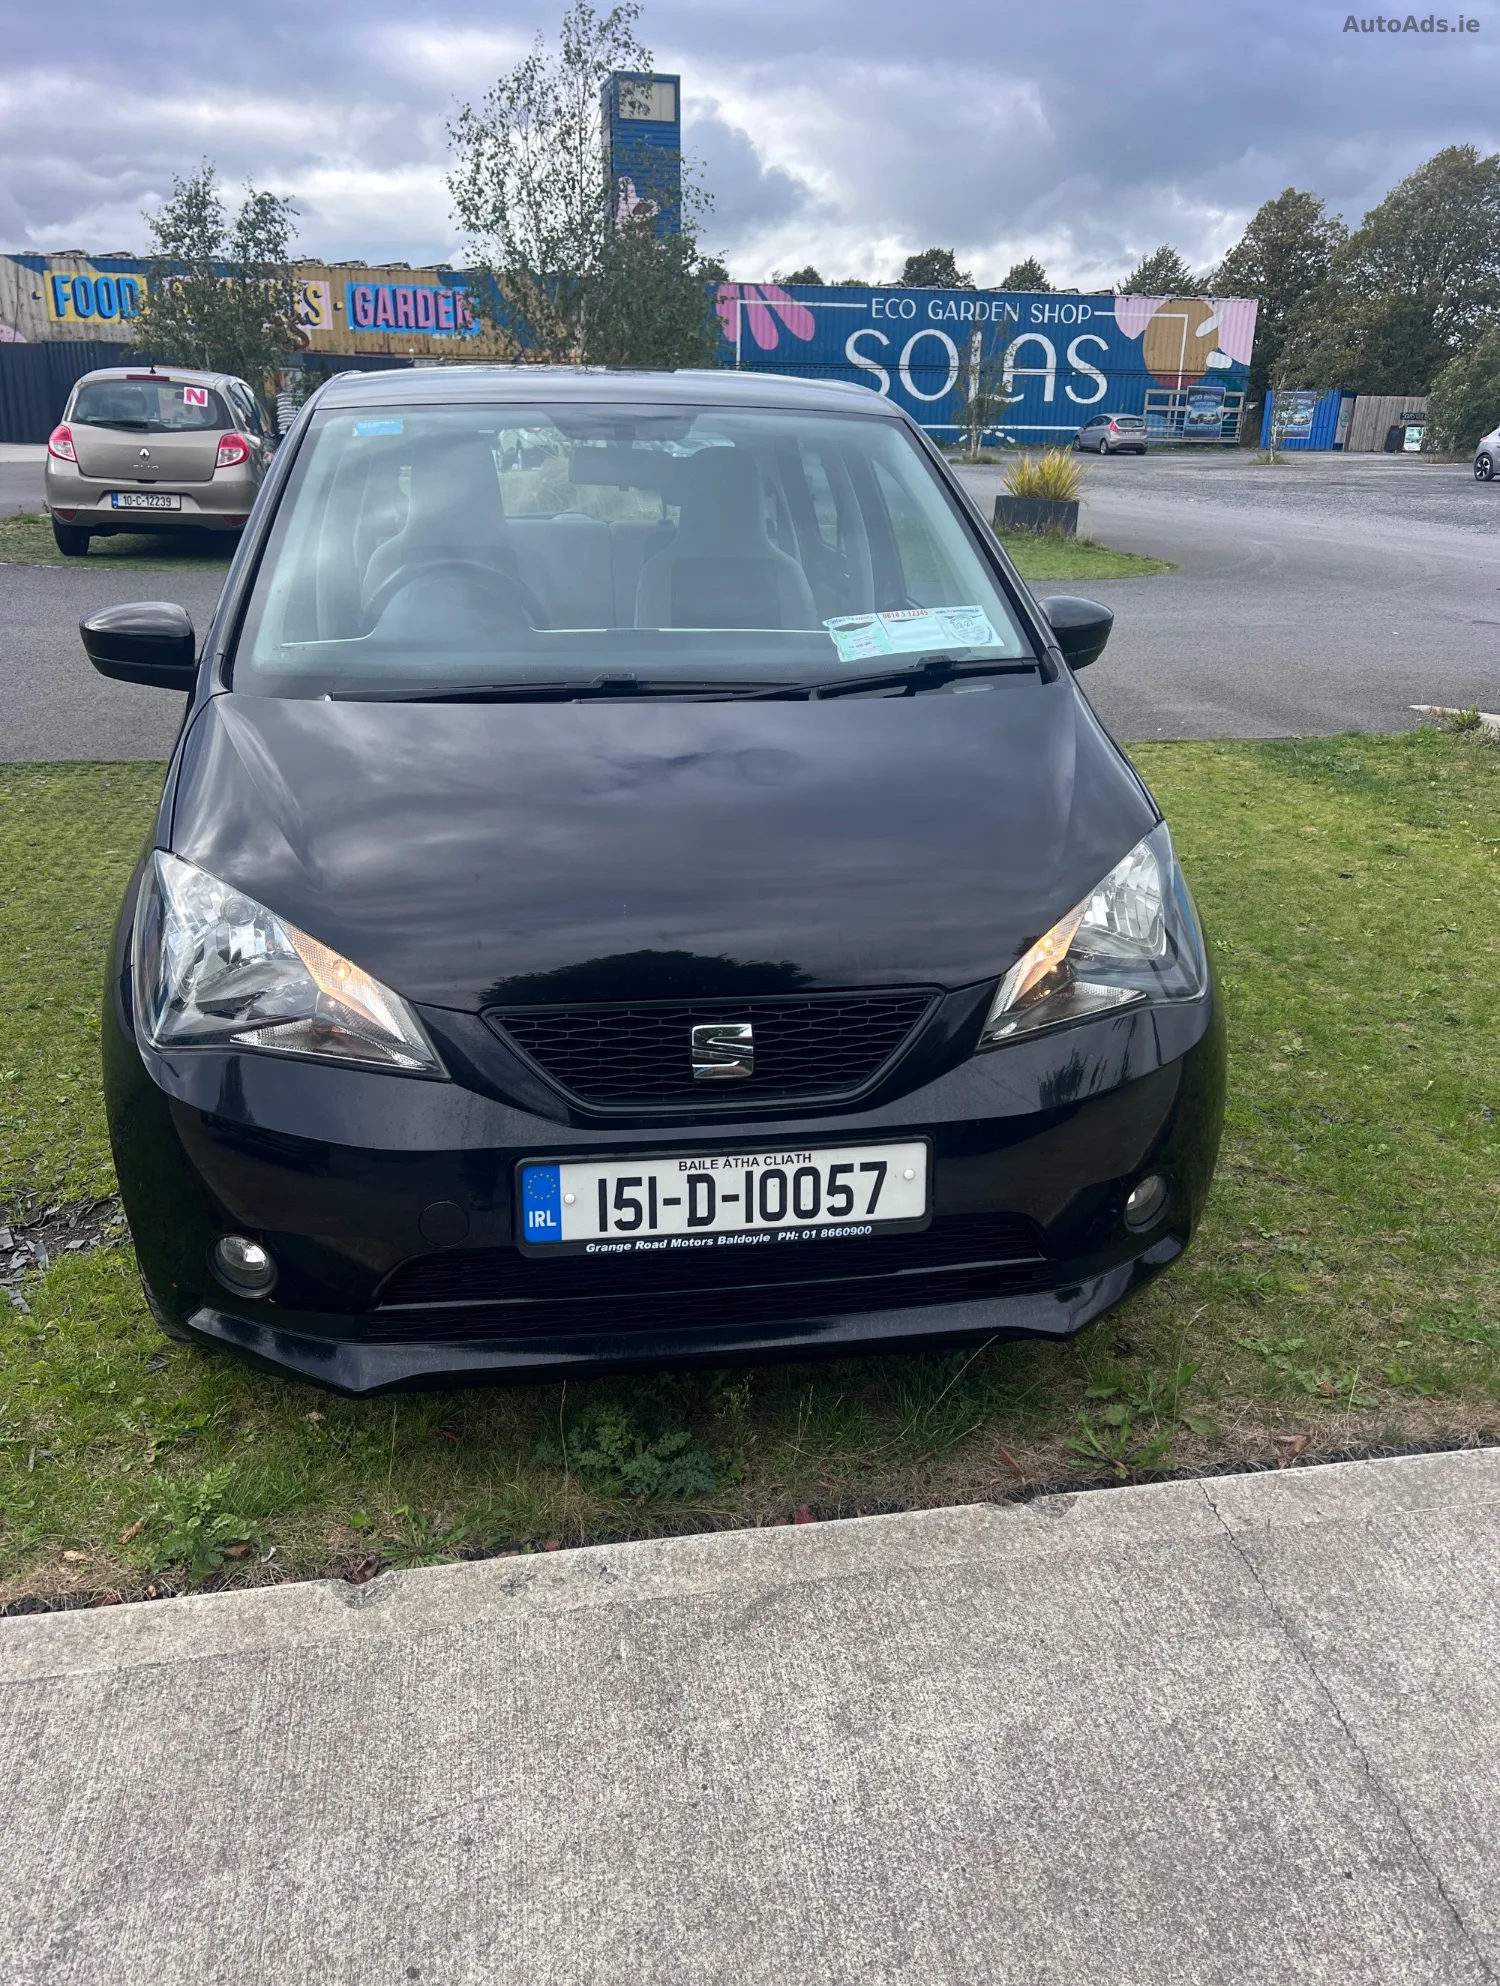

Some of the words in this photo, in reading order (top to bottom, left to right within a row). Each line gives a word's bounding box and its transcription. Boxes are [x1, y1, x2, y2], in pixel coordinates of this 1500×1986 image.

[51, 274, 140, 319] FOOD
[871, 298, 916, 319] ECO
[928, 300, 1020, 322] GARDEN
[1030, 303, 1091, 324] SHOP
[845, 328, 1109, 404] SOLAS
[186, 388, 205, 405] N
[123, 495, 171, 507] 10-C-12239
[678, 1159, 719, 1171] BAILE
[723, 1156, 760, 1169] ÁTHA
[763, 1153, 812, 1166] CLIATH
[598, 1161, 887, 1232] 151-D-10057
[528, 1210, 557, 1228] IRL
[585, 1243, 632, 1253] Grange
[635, 1240, 668, 1250] Road
[670, 1237, 714, 1248] Motors
[717, 1233, 771, 1245] Baldoyle
[777, 1231, 799, 1241] PH:
[802, 1230, 816, 1239] 01
[820, 1225, 872, 1238] 8660900
